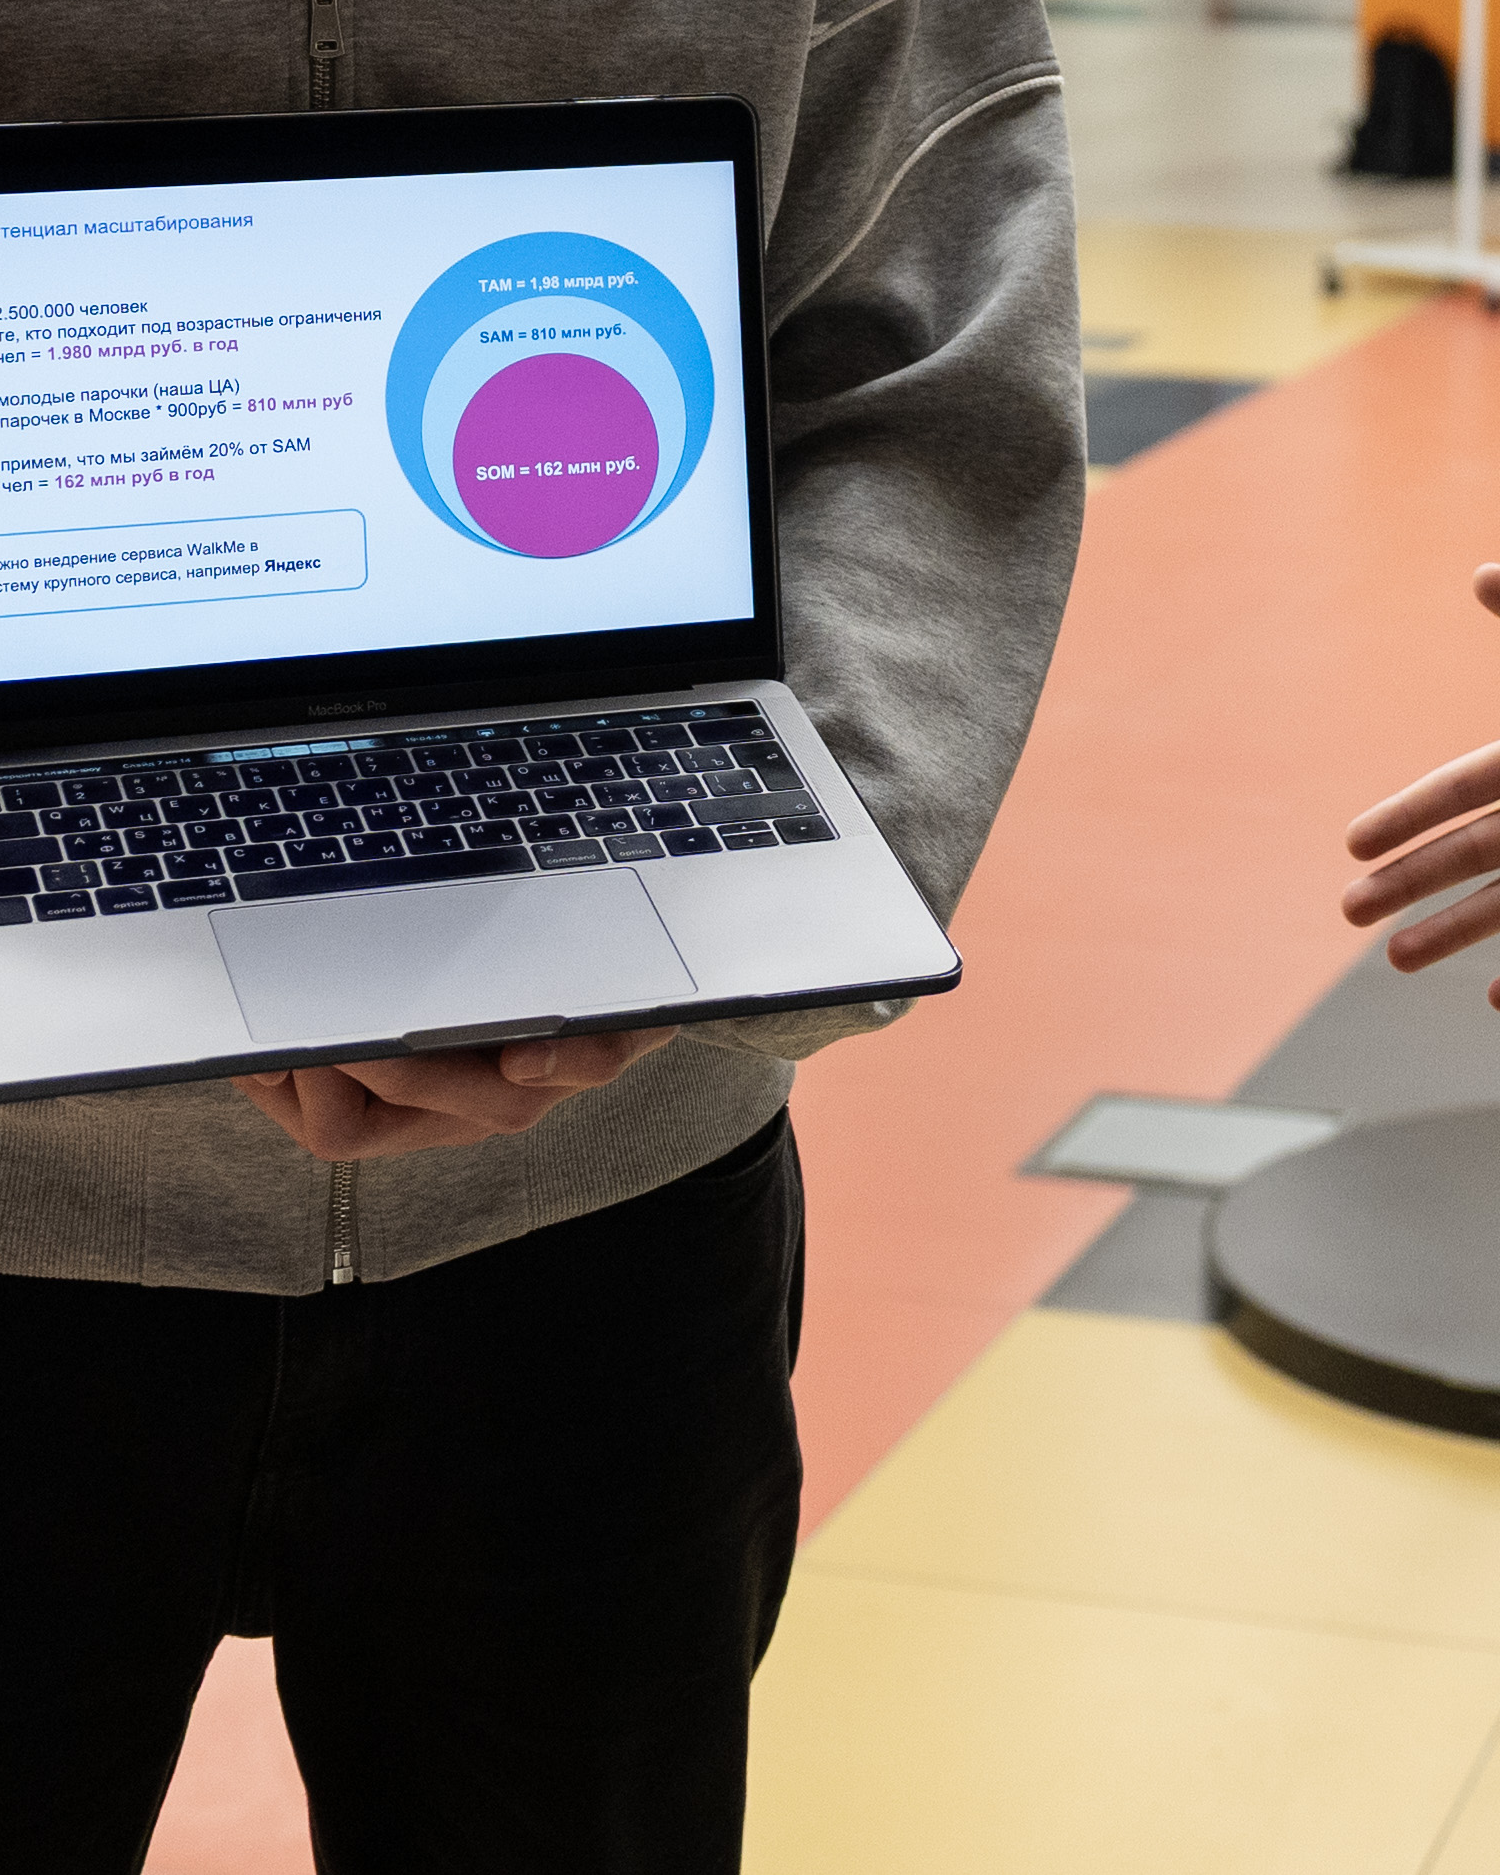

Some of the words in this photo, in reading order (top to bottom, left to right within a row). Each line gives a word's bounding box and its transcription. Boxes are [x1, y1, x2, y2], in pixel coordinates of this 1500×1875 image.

[84, 215, 253, 234] масштабирования
[478, 277, 512, 292] TAM
[530, 275, 559, 291] 1,98
[563, 276, 604, 290] млрд
[607, 271, 638, 288] руб.
[79, 302, 148, 315] человек
[25, 328, 52, 340] кто
[57, 323, 136, 340] подходит
[141, 321, 172, 334] под
[176, 316, 273, 333] возрастные
[278, 309, 381, 328] ограничения
[479, 329, 513, 343] SAM
[531, 327, 556, 340] 810
[561, 328, 591, 338] млн
[595, 323, 626, 340] руб.
[48, 344, 91, 359] 1.980
[98, 345, 145, 359] млрд
[151, 339, 187, 357] руб.
[193, 341, 203, 351] в
[209, 339, 238, 352] год
[80, 387, 148, 403] парочки
[153, 383, 203, 400] (наша
[208, 378, 239, 396] ЦА)
[0, 413, 69, 430] парочек
[74, 412, 83, 423] в
[89, 407, 150, 422] Москве
[167, 399, 226, 418] 900руб
[248, 397, 276, 411] 810
[282, 398, 316, 409] млн
[323, 392, 352, 410] руб
[1, 456, 71, 474] примем,
[76, 454, 105, 465] что
[110, 452, 135, 464] мы
[140, 445, 203, 462] займём
[208, 441, 244, 457] 20%
[249, 443, 268, 454] от
[272, 437, 310, 453] SAM
[476, 464, 514, 480] SOM
[534, 461, 563, 476] 162
[567, 461, 600, 474] млн
[605, 455, 640, 475] руб.
[2, 480, 32, 492] чел
[55, 474, 84, 488] 162
[91, 474, 125, 486] млн
[132, 468, 163, 487] руб
[169, 471, 179, 481] в
[185, 468, 214, 481] год
[34, 552, 116, 568] внедрение
[121, 547, 182, 563] сервиса
[186, 540, 245, 556] WalkMe
[250, 542, 258, 551] в
[44, 575, 111, 592] крупного
[115, 569, 181, 585] сервиса,
[186, 563, 260, 579] например
[264, 558, 321, 573] Яндекс
[308, 702, 365, 716] MacBook
[367, 700, 387, 711] Pro
[546, 853, 597, 864] command
[619, 848, 652, 857] option
[47, 906, 87, 915] control
[113, 900, 149, 909] option
[173, 891, 226, 903] command
